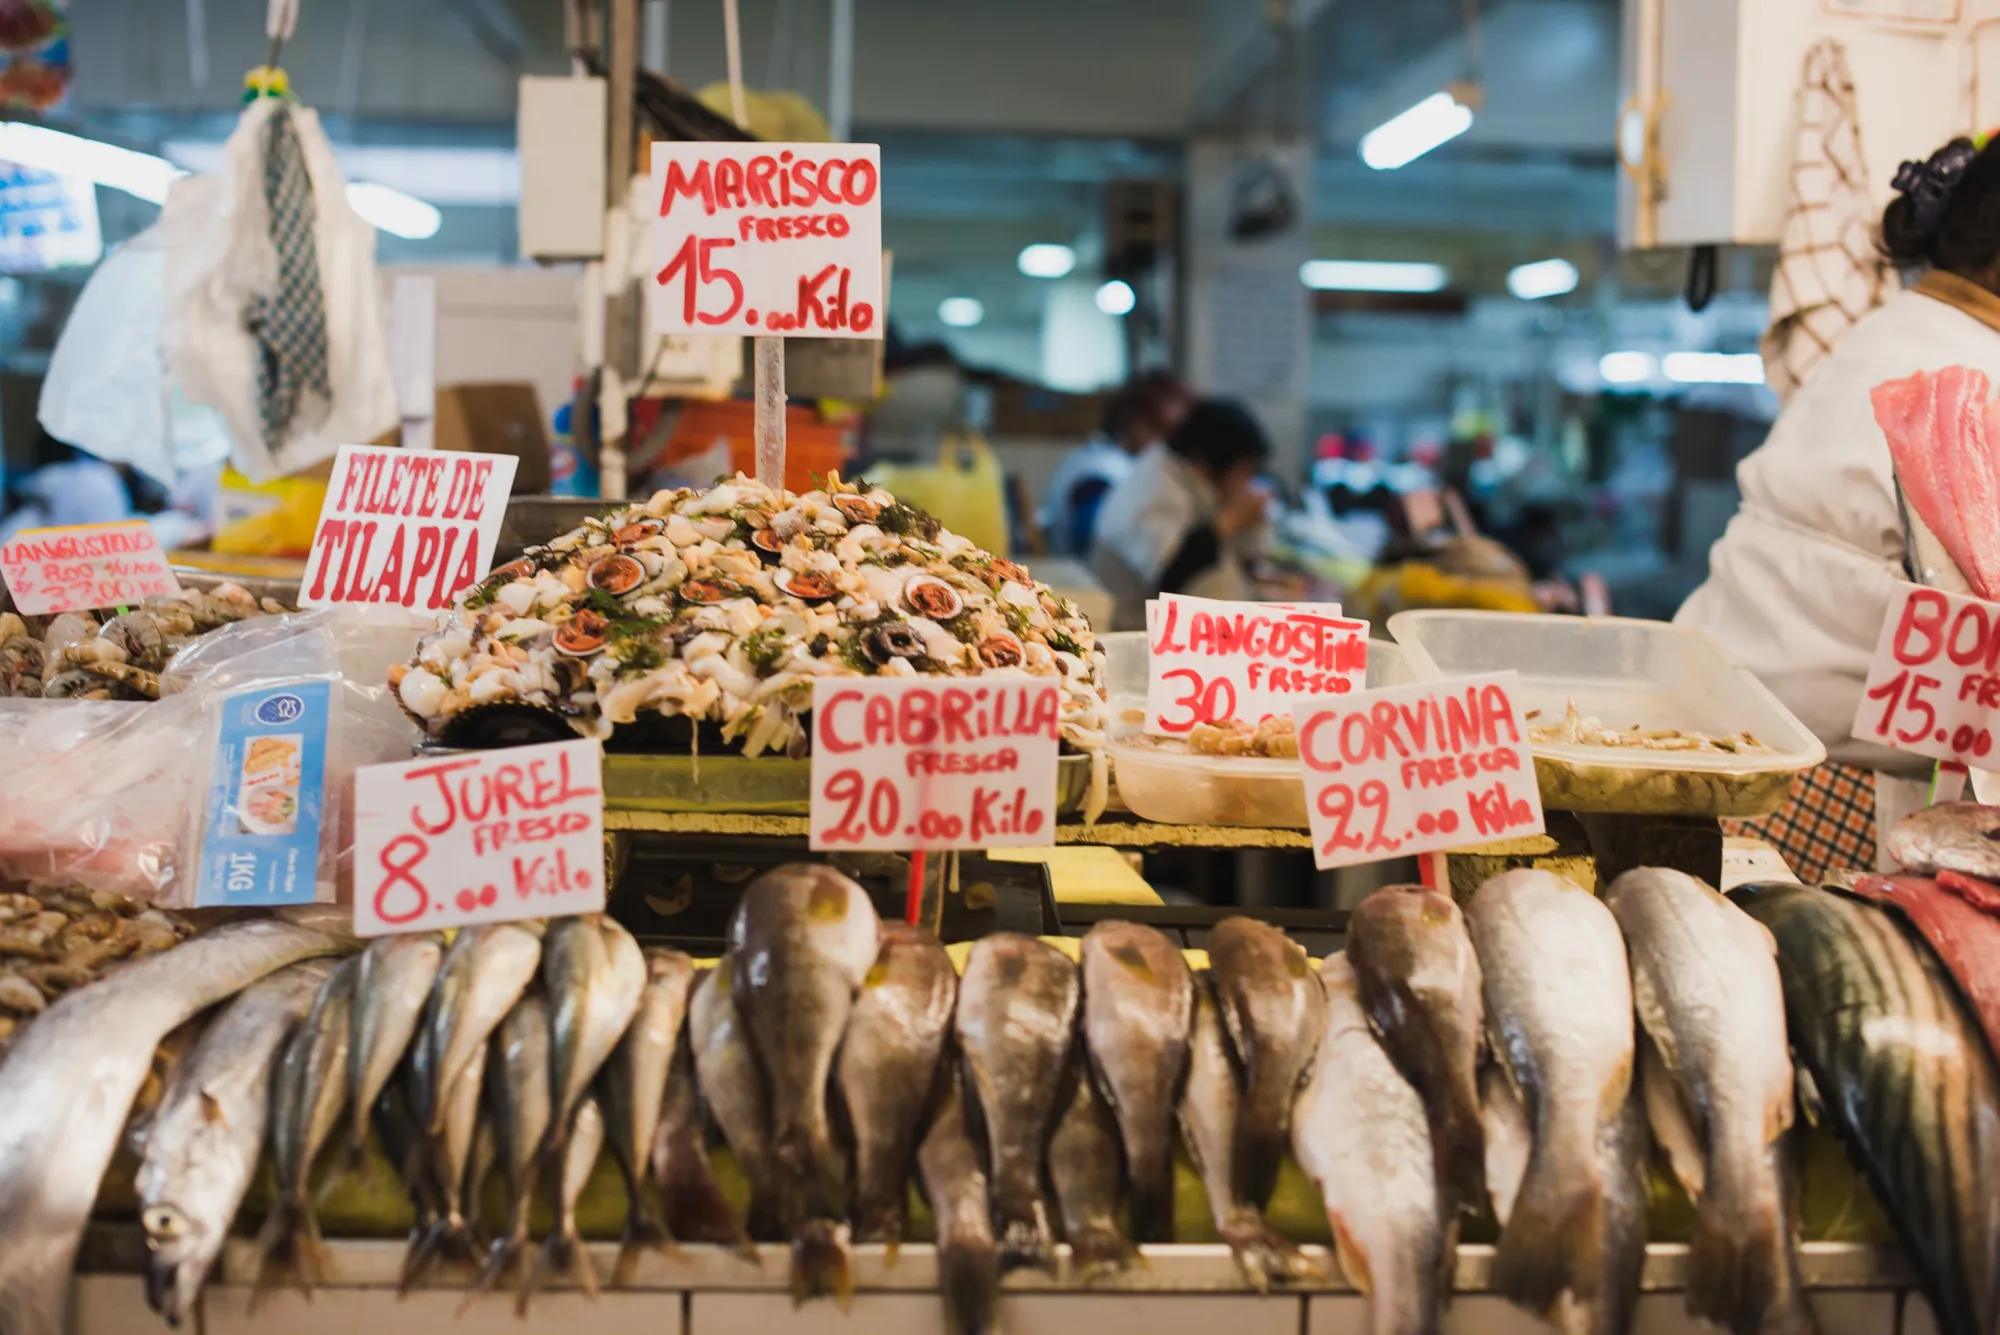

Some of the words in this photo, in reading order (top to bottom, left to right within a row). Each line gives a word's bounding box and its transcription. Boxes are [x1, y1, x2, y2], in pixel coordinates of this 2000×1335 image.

[738, 213, 850, 242] FRESCO
[797, 264, 874, 332] Kilo
[336, 453, 447, 518] FILETE
[441, 458, 493, 521] DE
[308, 518, 479, 611] TILAPIA
[1247, 662, 1352, 694] FRESCO
[905, 747, 1019, 778] FRESCA
[1401, 746, 1521, 790] FRESCA
[404, 751, 598, 836] JUREL
[820, 768, 964, 845] 20.00
[970, 786, 1044, 842] Kilo
[1316, 779, 1460, 857] 22.00
[1466, 780, 1535, 836] Kilo
[226, 851, 258, 893] 1KG
[512, 848, 592, 900] Kilo
